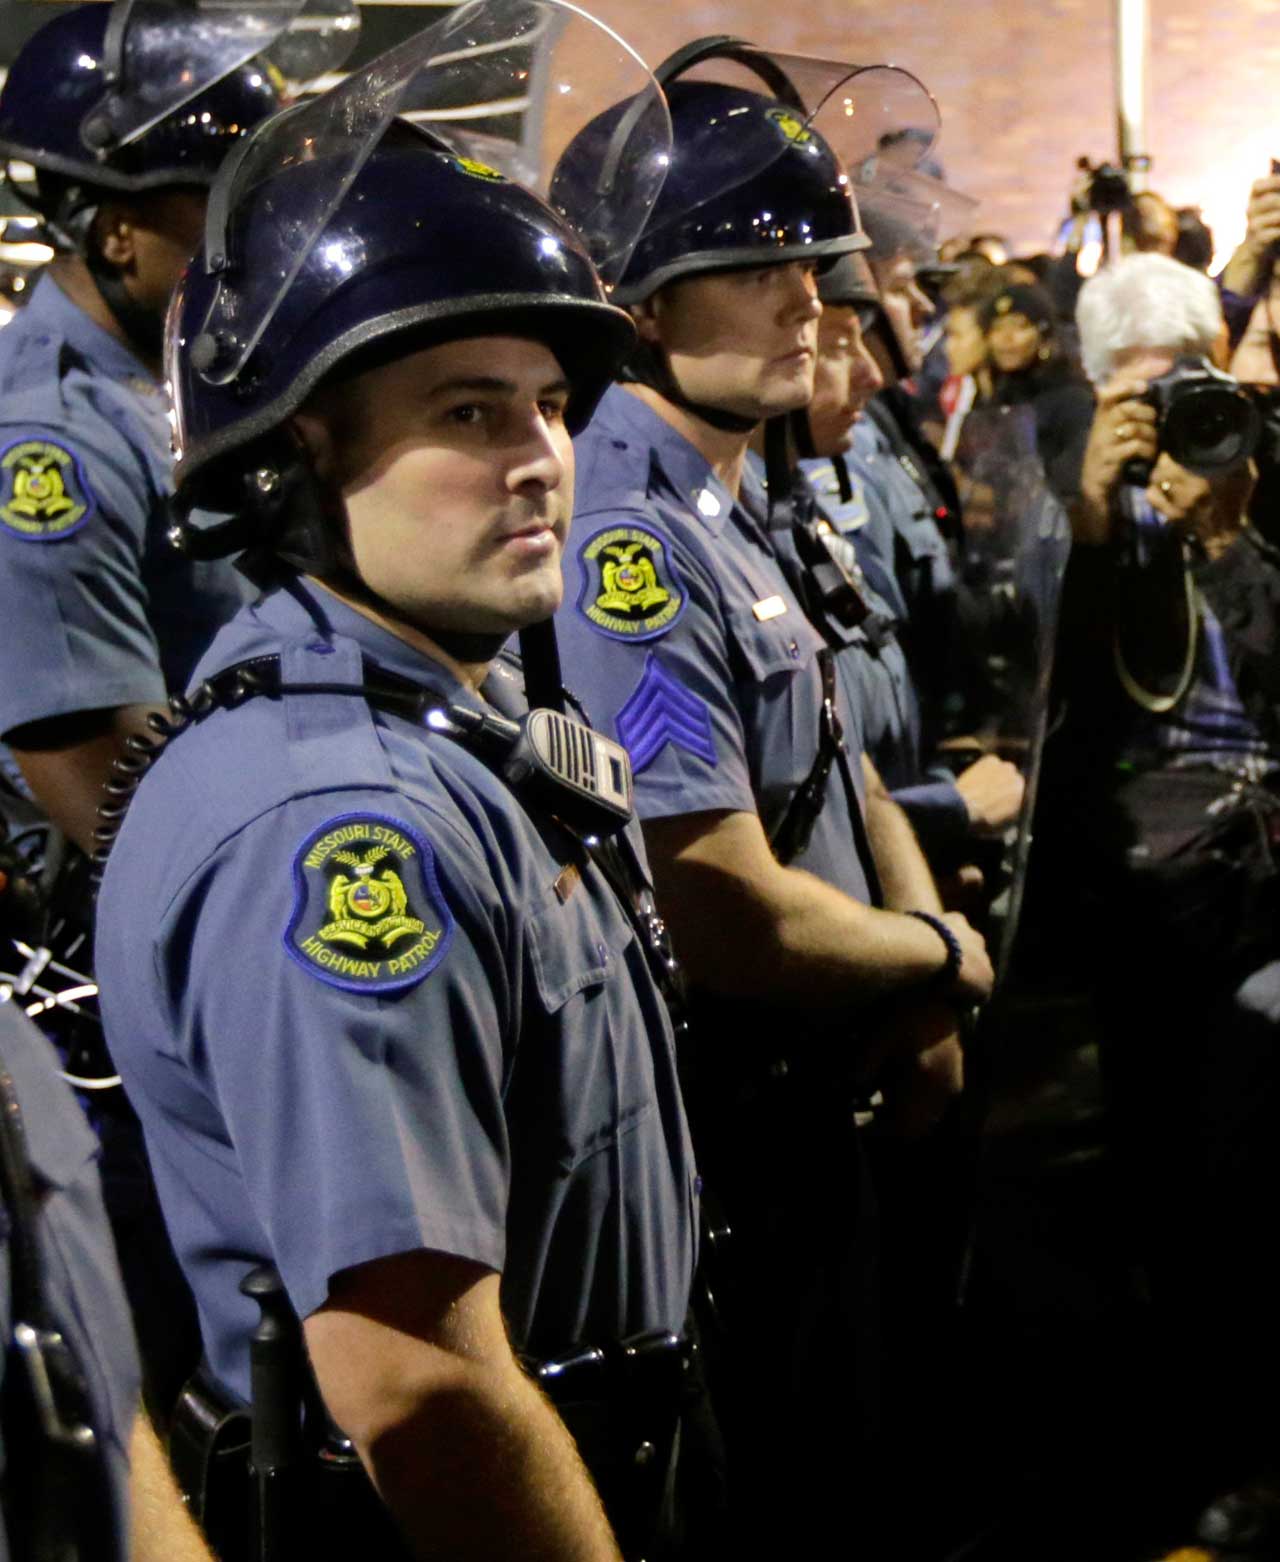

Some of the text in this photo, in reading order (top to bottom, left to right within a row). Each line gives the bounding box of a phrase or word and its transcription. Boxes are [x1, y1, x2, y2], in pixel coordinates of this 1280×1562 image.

[304, 824, 416, 868] MISSOURI STATE
[301, 930, 442, 977] HIGHWAY PATROL
